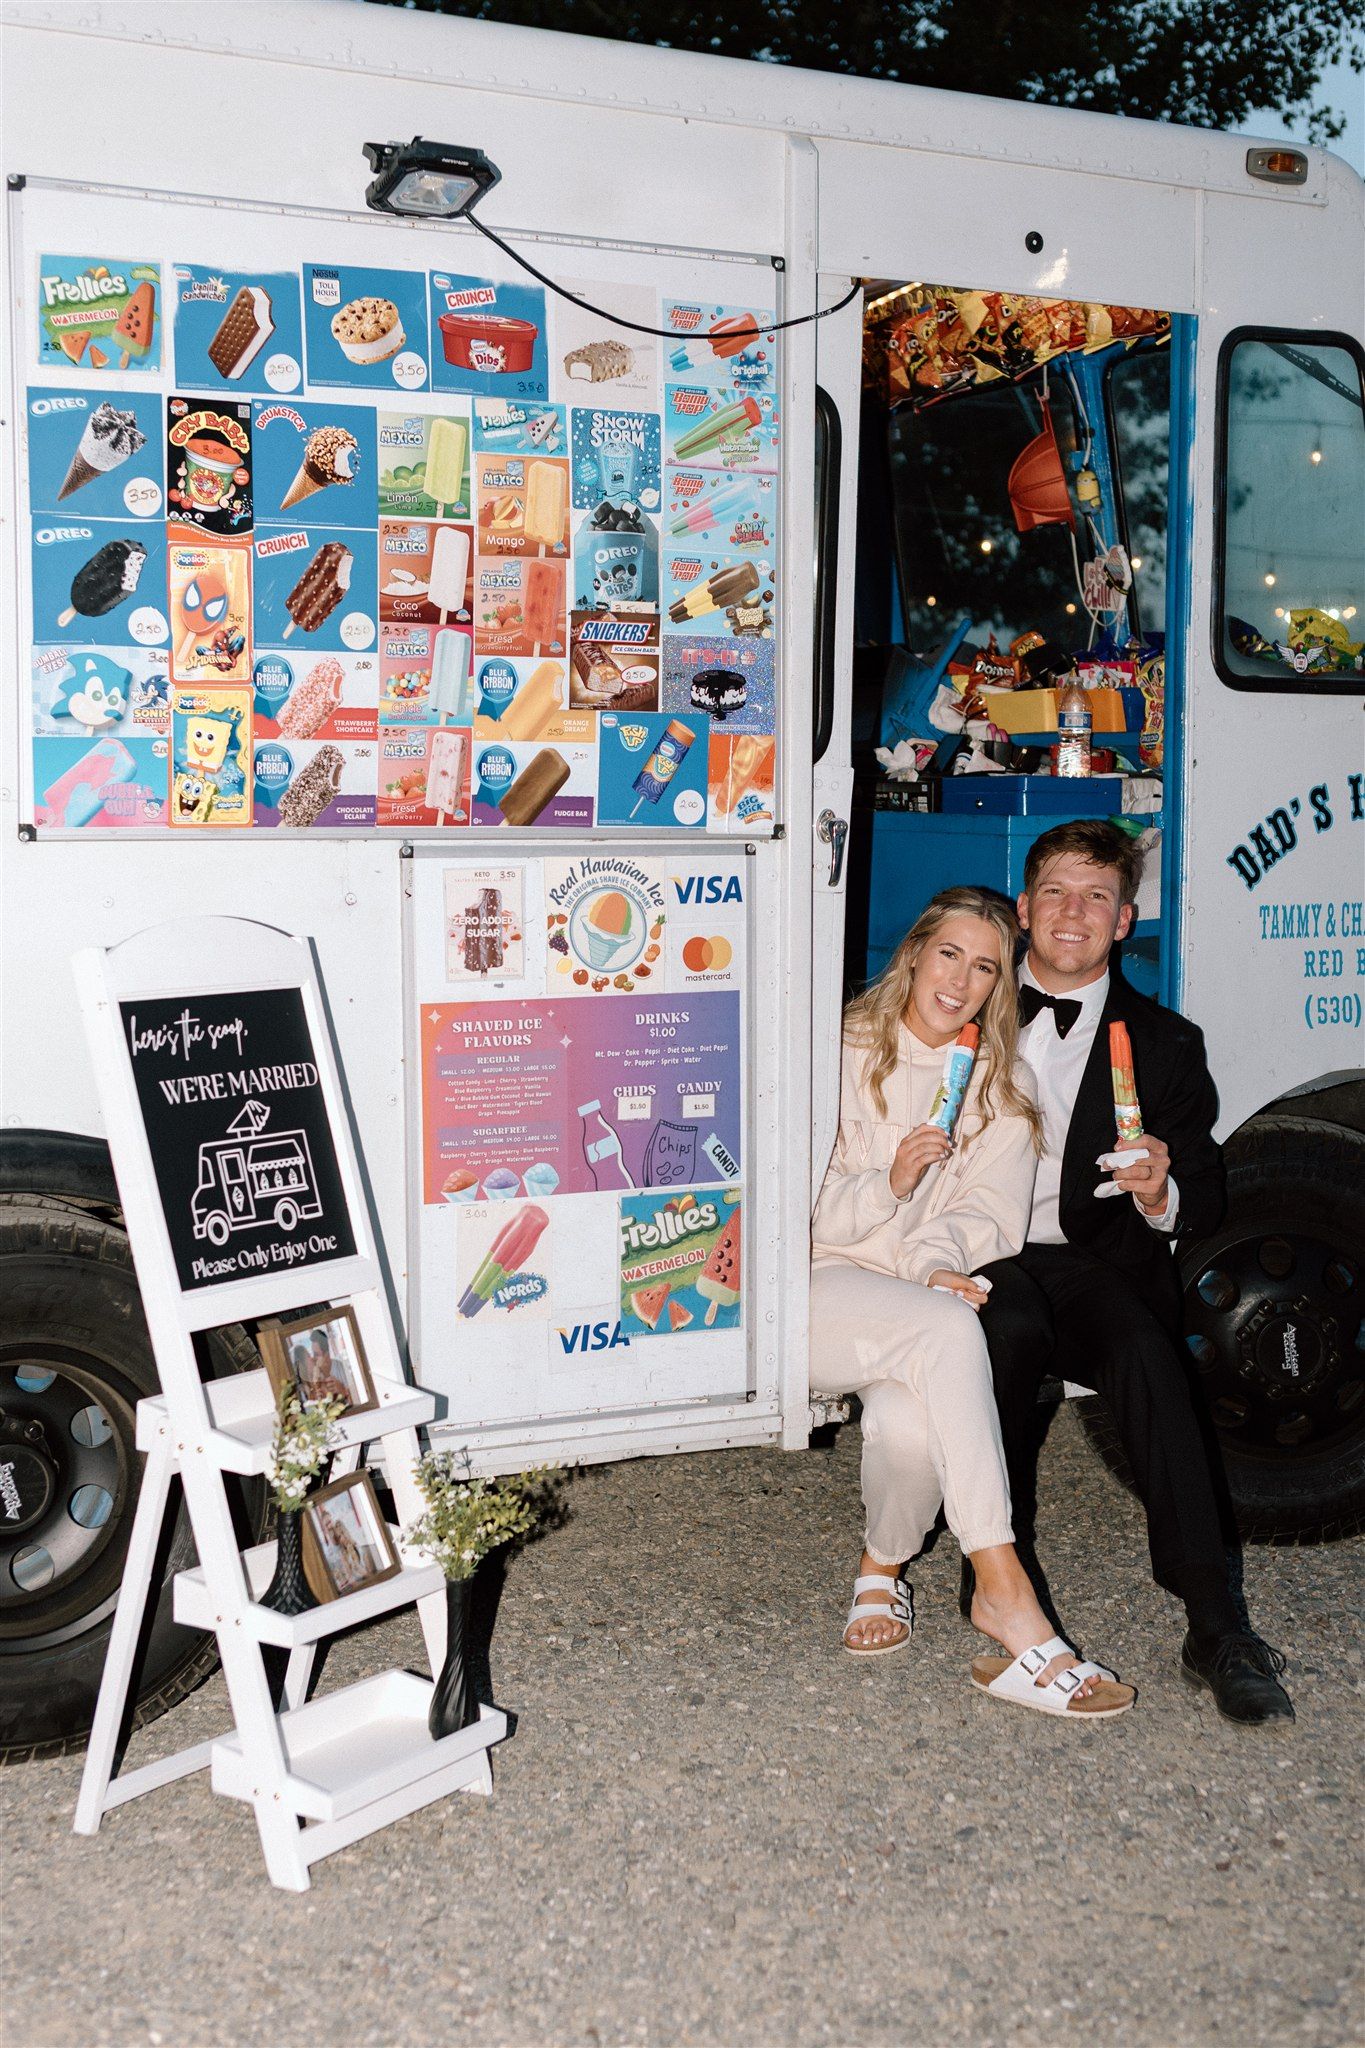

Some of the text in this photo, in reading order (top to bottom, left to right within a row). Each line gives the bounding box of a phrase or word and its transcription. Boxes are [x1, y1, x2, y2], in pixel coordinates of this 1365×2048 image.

[41, 276, 128, 306] Frollies
[192, 283, 218, 292] Vanilla
[315, 289, 338, 297] HOUSE
[182, 292, 226, 302] Sandwiches
[447, 289, 495, 307] CRUNCH
[52, 310, 119, 326] WATERMELON
[475, 353, 500, 367] Dibs
[395, 363, 425, 376] 3.50
[731, 364, 769, 378] Original
[518, 382, 544, 394] 3.50
[32, 398, 87, 415] OREO
[676, 403, 705, 416] POP
[256, 406, 307, 431] DRUMSTICK
[592, 412, 645, 430] SNOW
[171, 412, 249, 451] CRY BABY
[590, 427, 645, 452] STORM
[128, 489, 158, 503] 3.50
[387, 492, 418, 503] Limón
[36, 527, 92, 544] OREO
[486, 534, 526, 547] Mango
[257, 534, 307, 555] CRUNCH
[594, 545, 638, 564] OREO
[393, 600, 418, 611] Coco
[488, 633, 513, 643] Fresa
[581, 622, 649, 642] SNICKERS
[263, 665, 282, 673] BLUE
[256, 673, 288, 687] RIBBON
[483, 676, 513, 689] RIBBON
[134, 708, 169, 718] SONIC
[334, 719, 375, 727] STRAWBERRY
[563, 719, 589, 727] ORANGE
[262, 754, 282, 762] BLUE
[487, 756, 506, 764] BLUE
[256, 761, 288, 775] RIBBON
[481, 763, 512, 776] RIBBON
[391, 802, 416, 813] Fresa
[384, 814, 423, 822] Strawberry
[1226, 782, 1334, 892] DAD'S
[548, 857, 665, 907] Real Hawaiian Ice
[564, 876, 652, 909] THE ORIGINAL SHAVE ICE COMPANY
[671, 876, 743, 904] VISA
[453, 917, 479, 925] ZERO
[1259, 902, 1365, 940] TAMMY & CH
[467, 929, 501, 937] SUGAR
[1304, 949, 1344, 978] RED
[685, 972, 731, 982] mastercard
[1304, 993, 1362, 1029] (530)
[452, 1018, 542, 1033] SHAVED ICE
[635, 1012, 690, 1025] DRINKS
[131, 1015, 179, 1056] here's
[173, 1009, 205, 1061] the
[650, 1027, 676, 1038] $1.00
[464, 1034, 532, 1048] FLAVORS
[645, 1048, 661, 1056] Pepsi
[713, 1044, 729, 1052] Pepsi
[477, 1055, 520, 1064] REGULAR
[635, 1058, 656, 1067] Pepper
[158, 1062, 319, 1105] WE'RE MARRIED
[613, 1084, 657, 1097] CHIPS
[676, 1081, 722, 1094] CANDY
[472, 1126, 528, 1136] SUGARFREE
[658, 1135, 693, 1158] Chips
[711, 1144, 740, 1178] CANDY
[620, 1203, 717, 1256] Frollies
[191, 1234, 338, 1280] Please Only Enjoy One
[622, 1249, 706, 1283] WATERMELON
[556, 1321, 630, 1354] VISA
[1287, 1322, 1300, 1377] American
